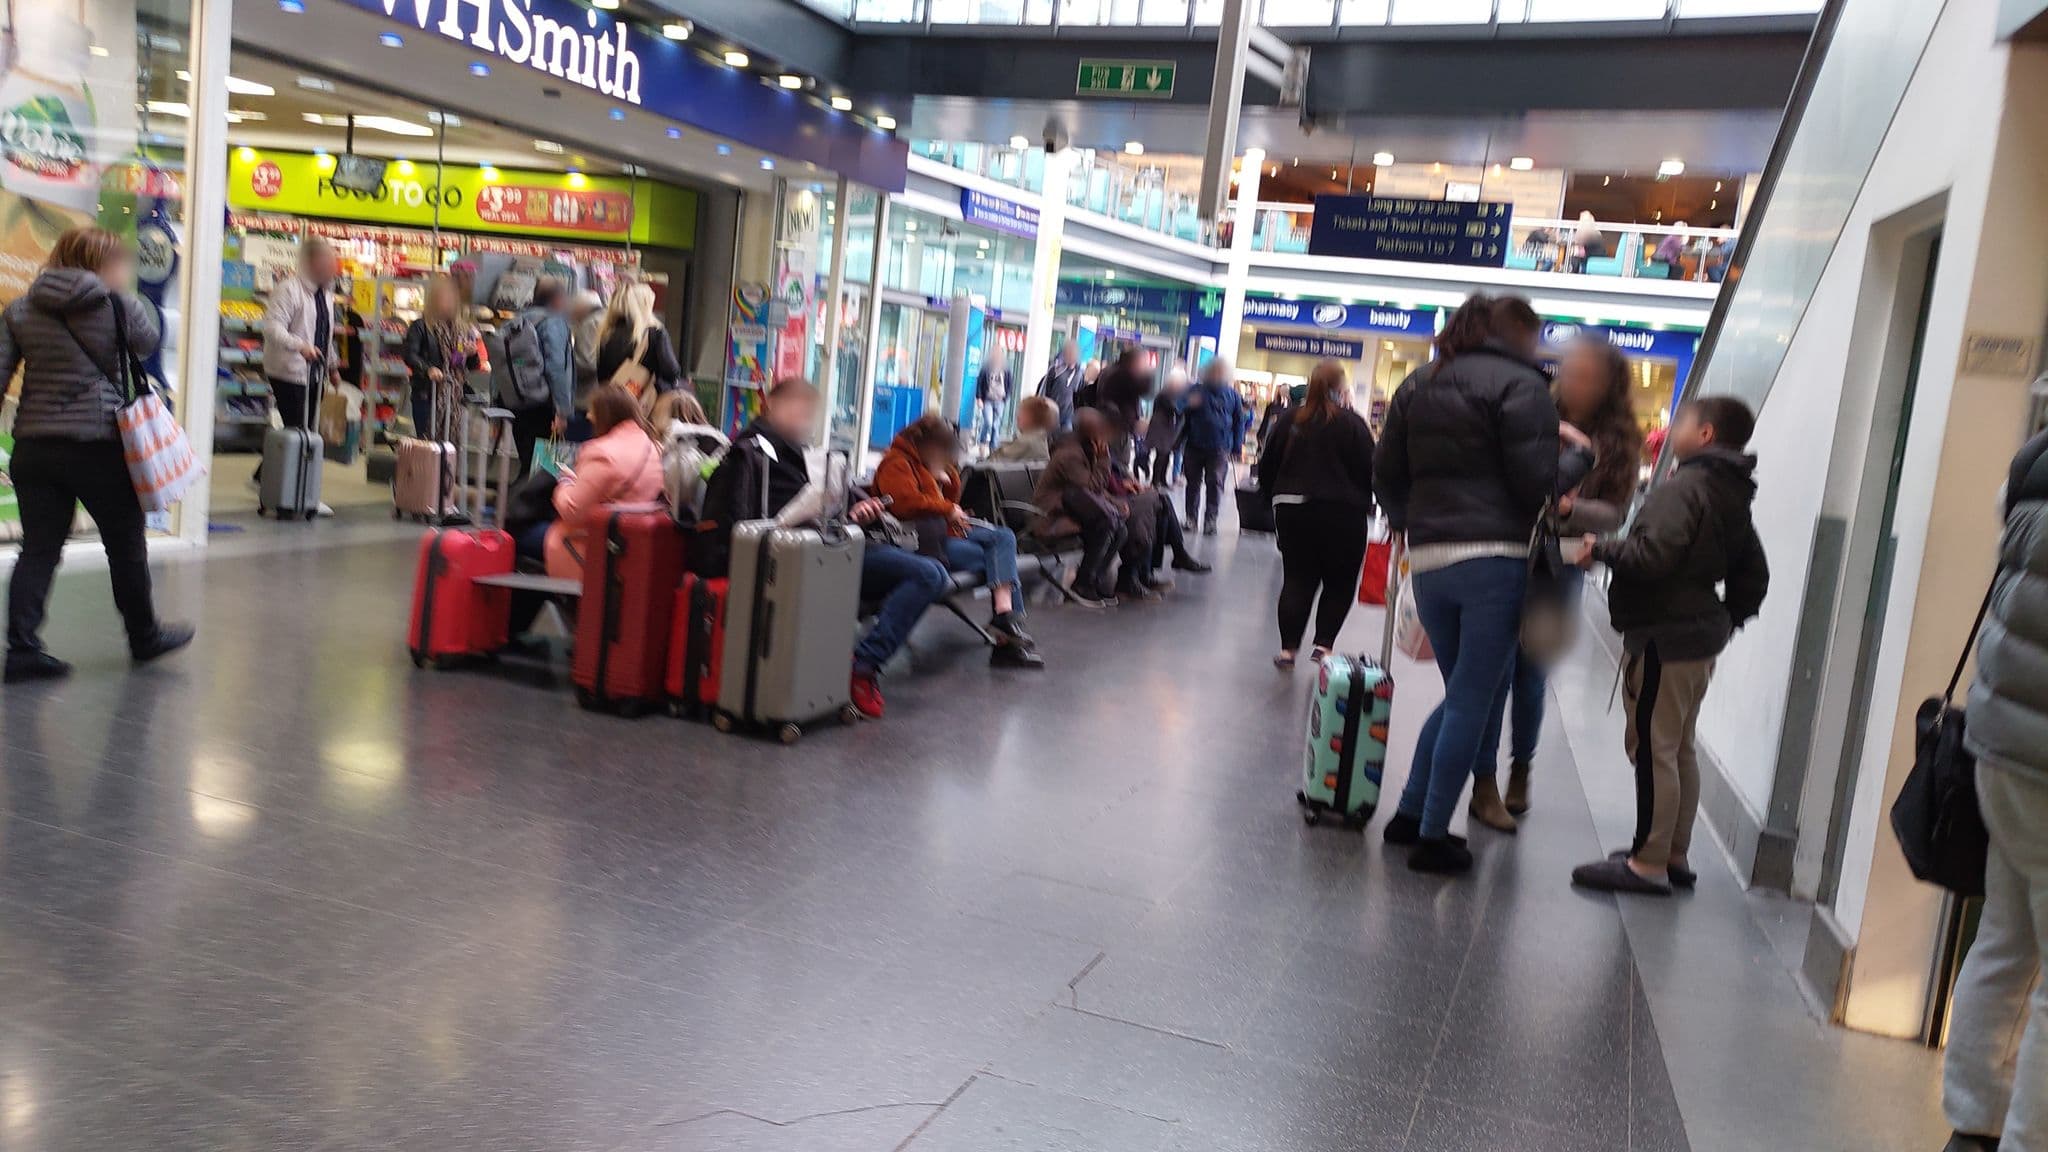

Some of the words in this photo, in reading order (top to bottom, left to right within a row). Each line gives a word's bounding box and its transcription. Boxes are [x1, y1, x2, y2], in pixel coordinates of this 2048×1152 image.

[389, 179, 424, 208] TO
[424, 185, 463, 209] GO
[1368, 199, 1393, 216] Long
[1395, 200, 1416, 216] stay
[1418, 202, 1434, 215] car
[1437, 203, 1461, 217] park
[1332, 214, 1367, 231] Tickets
[1369, 218, 1388, 233] and
[1391, 217, 1420, 234] Travel
[1422, 219, 1458, 235] Centre
[1375, 237, 1425, 255] Platforms
[1433, 240, 1445, 254] to
[1448, 240, 1456, 256] 7
[1243, 299, 1300, 321] pharmacy
[1369, 308, 1412, 330] beauty
[1264, 335, 1308, 353] welcome
[1310, 338, 1320, 353] to
[1322, 340, 1353, 358] Boots
[1608, 327, 1655, 352] beauty
